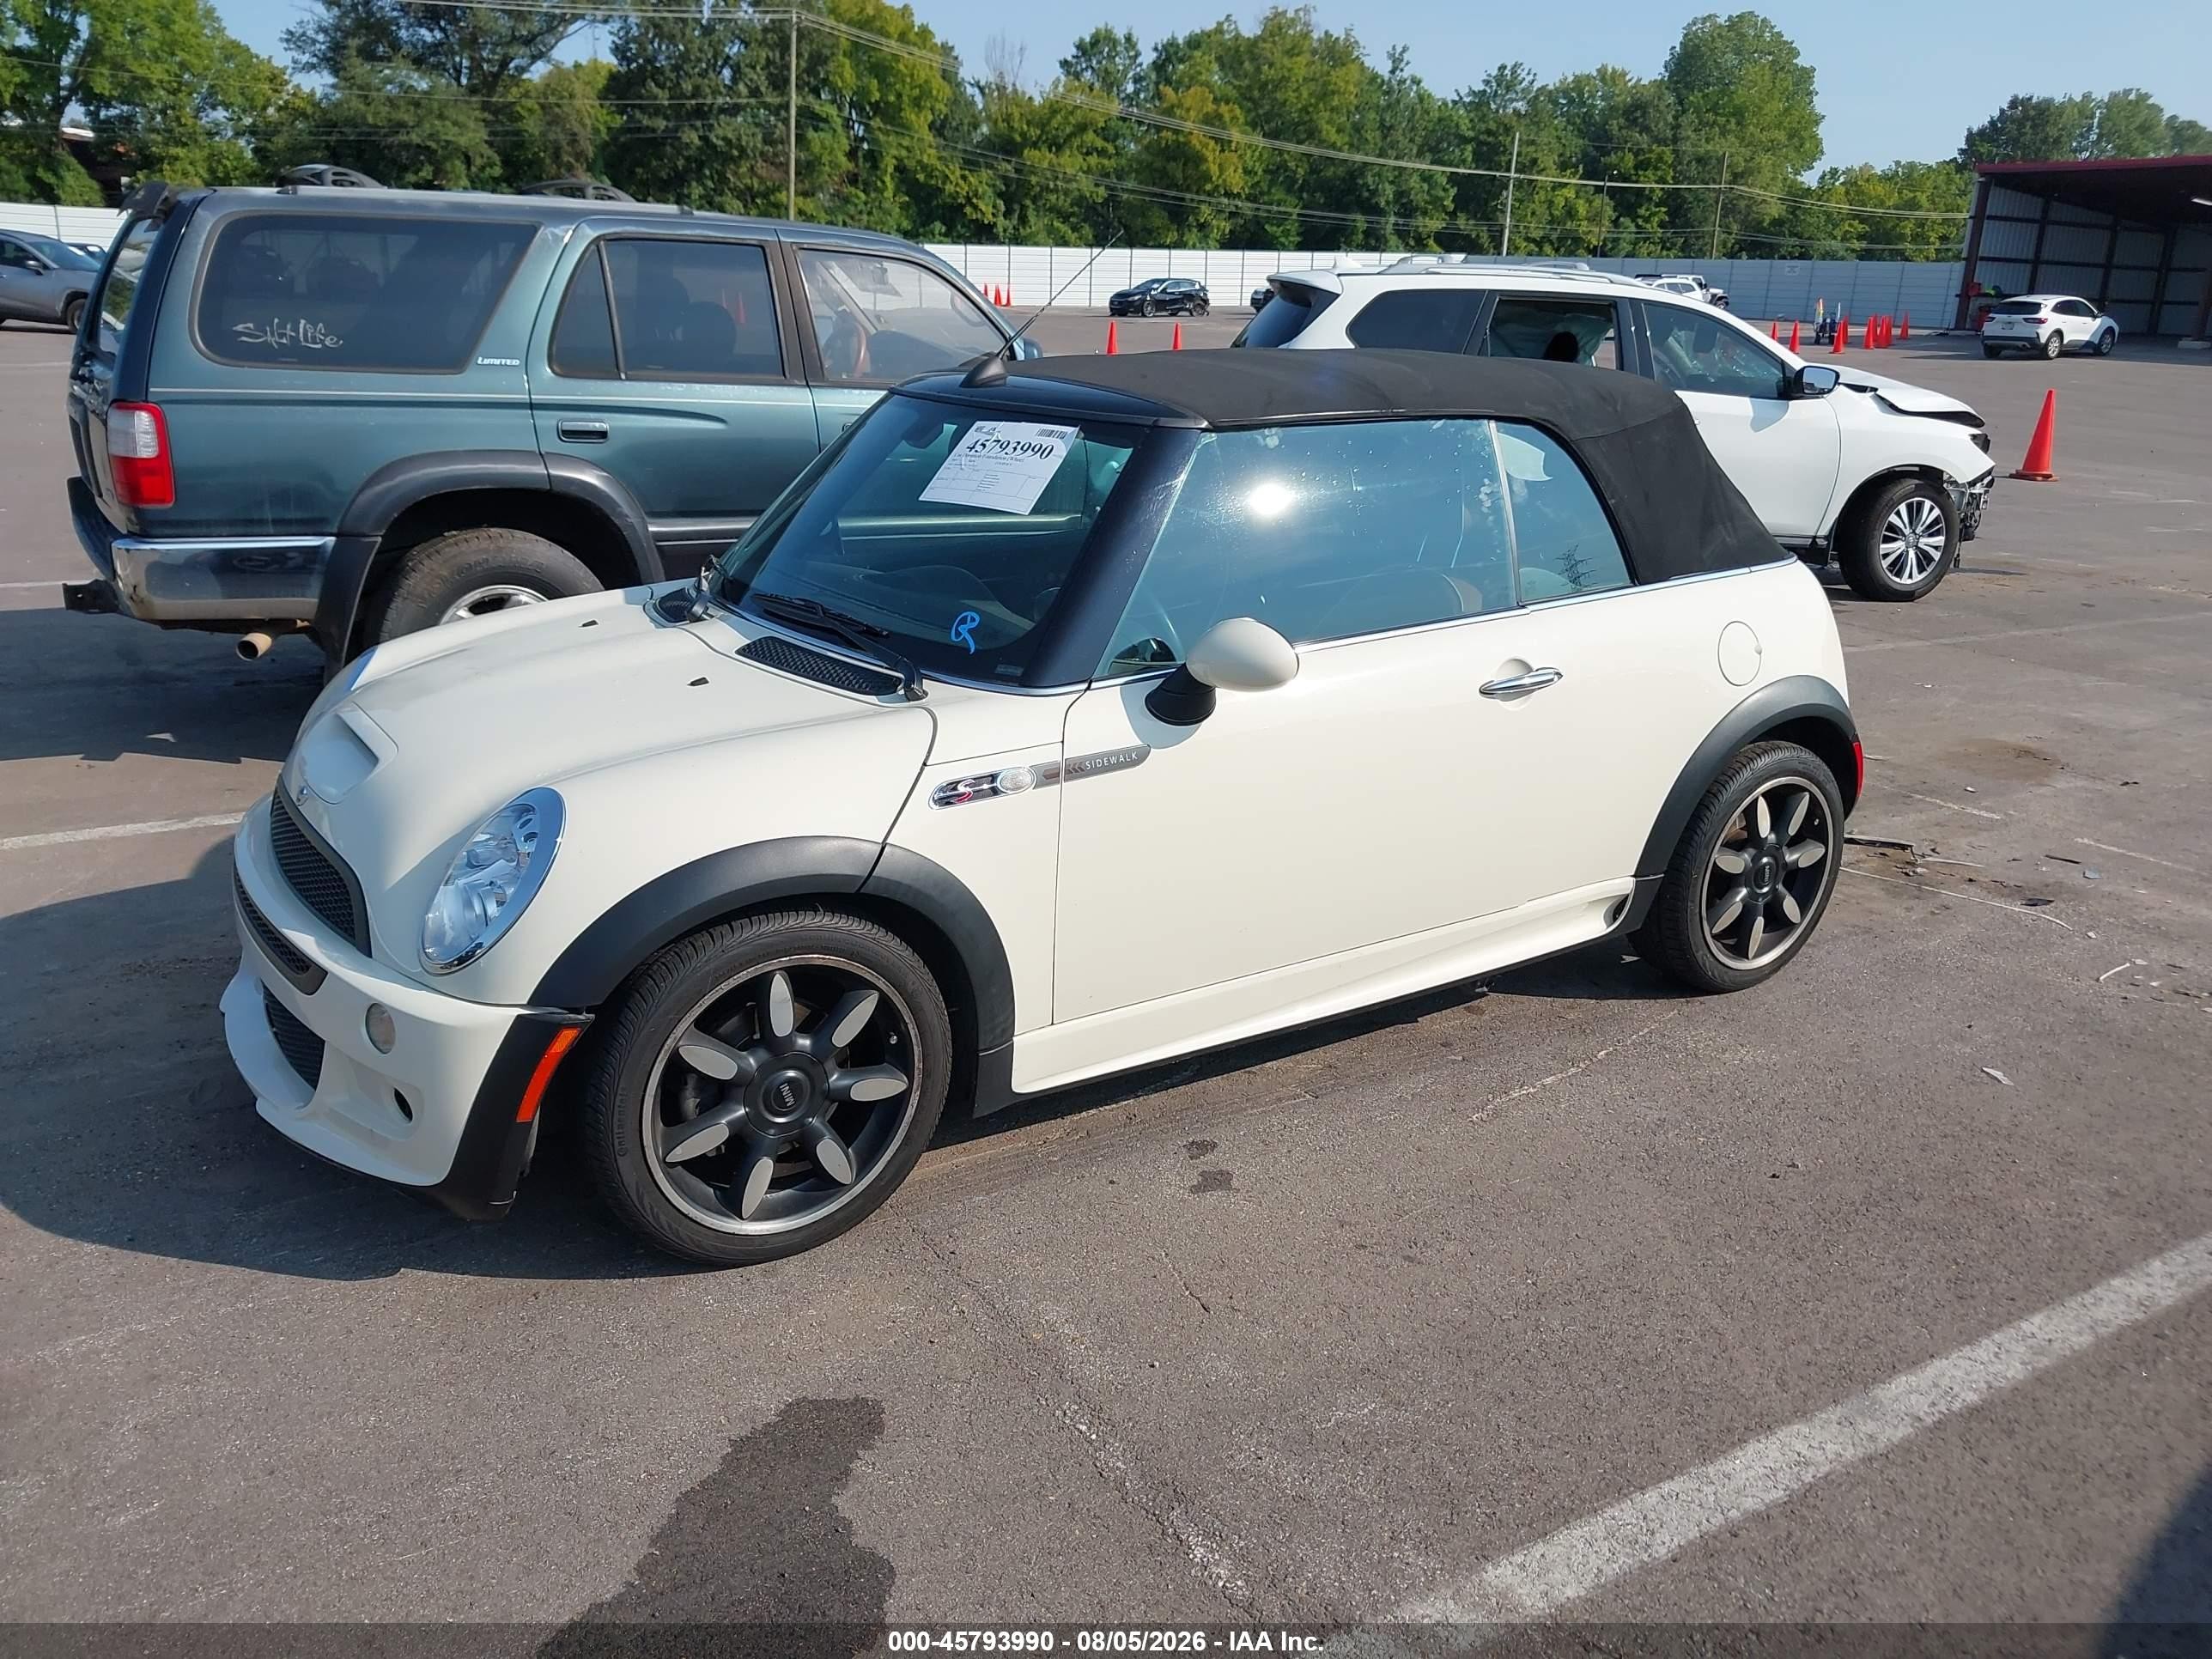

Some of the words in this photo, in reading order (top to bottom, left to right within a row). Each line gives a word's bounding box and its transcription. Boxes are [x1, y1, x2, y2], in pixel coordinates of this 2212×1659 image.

[966, 439, 1054, 460] 45793990
[1085, 751, 1139, 769] SIDEWALK
[779, 1083, 797, 1107] MINI
